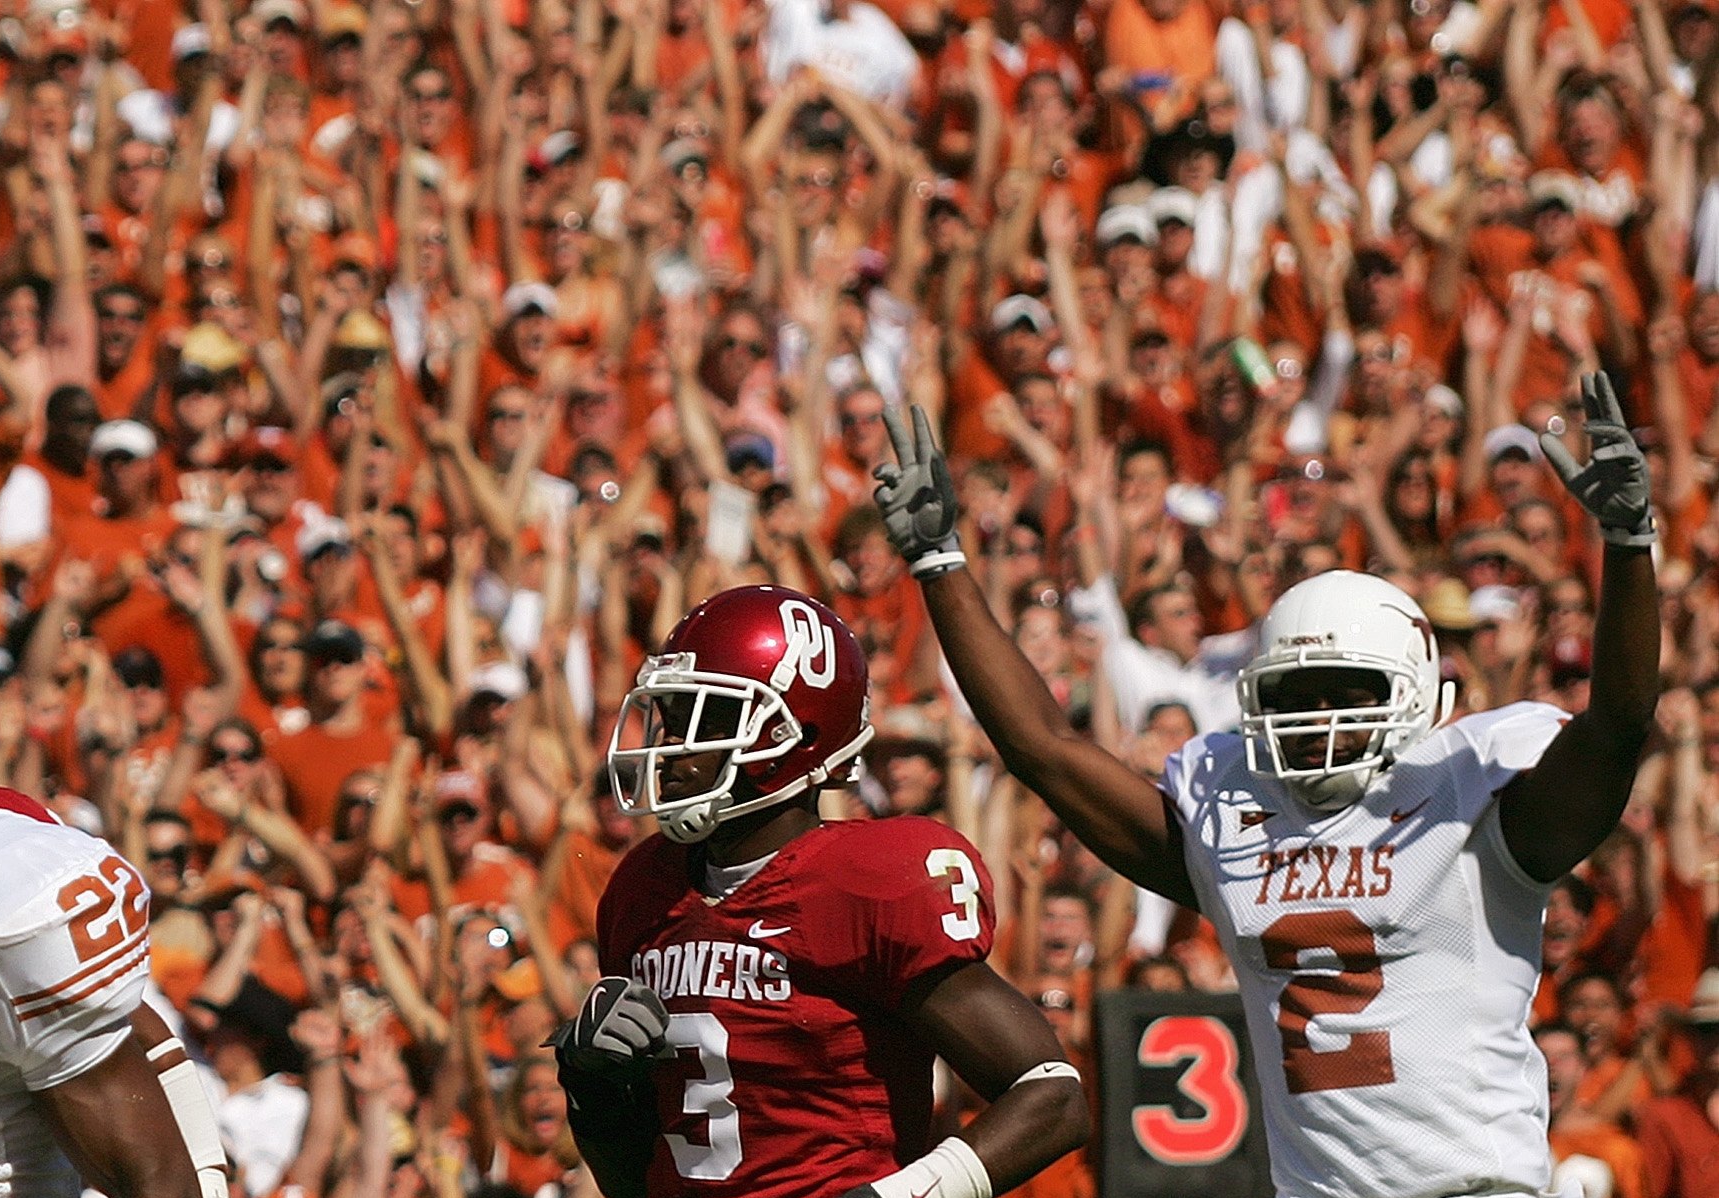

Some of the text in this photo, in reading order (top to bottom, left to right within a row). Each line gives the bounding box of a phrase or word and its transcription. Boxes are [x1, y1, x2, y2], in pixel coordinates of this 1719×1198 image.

[56, 855, 149, 964] 22
[925, 848, 981, 941] 3
[1255, 845, 1395, 905] TEXAS
[1260, 909, 1396, 1095] 2
[662, 1012, 743, 1181] 3
[1132, 1015, 1248, 1166] 3
